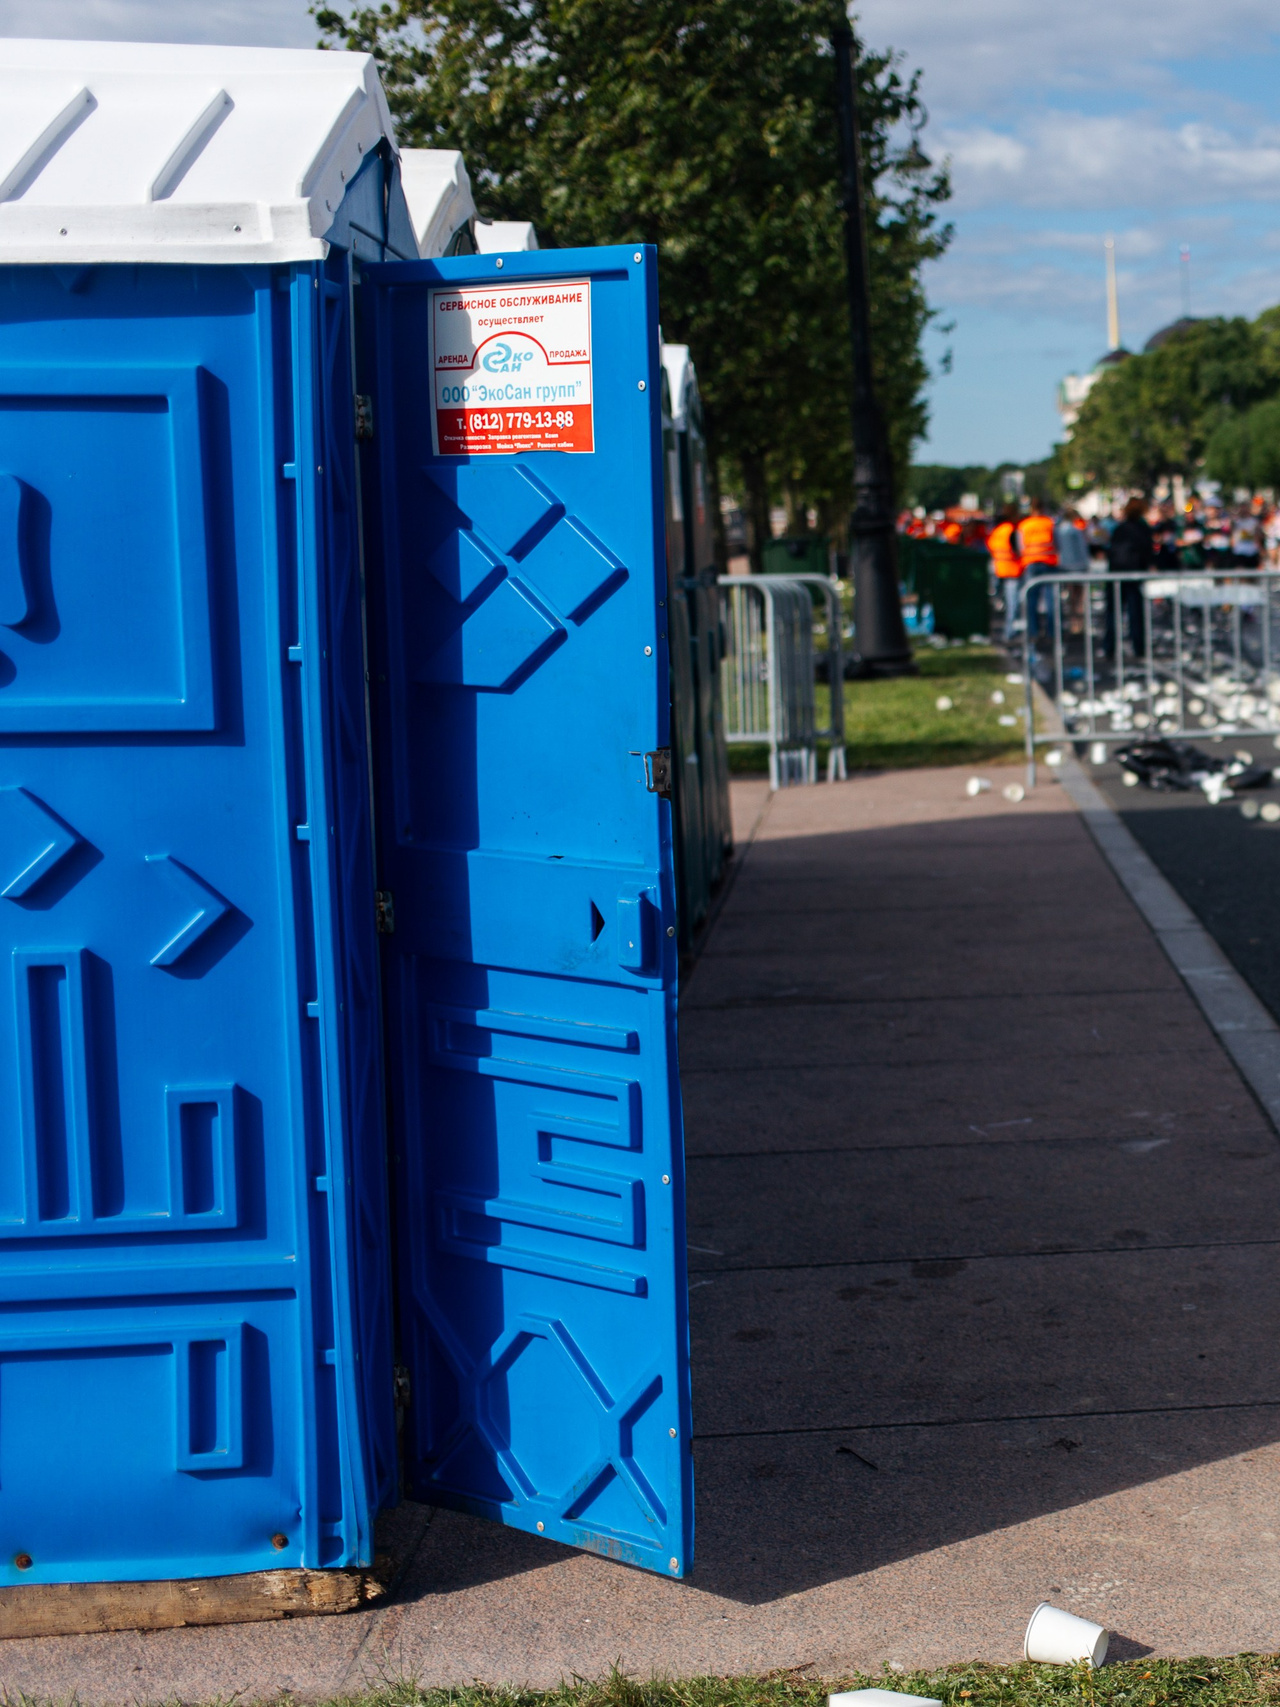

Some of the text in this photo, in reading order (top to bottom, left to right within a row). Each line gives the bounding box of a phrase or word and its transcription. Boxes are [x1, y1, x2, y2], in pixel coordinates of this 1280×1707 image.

[439, 292, 583, 311] СЕРВИСНОЕ ОБСЛУЖИВАНИЕ
[477, 315, 545, 328] осуществляет
[438, 354, 469, 364] АРЕНДА
[549, 349, 588, 359] ПРОДАЖА
[442, 386, 471, 404] ООО
[469, 413, 504, 433] (812)
[506, 411, 574, 430] 779-13-88
